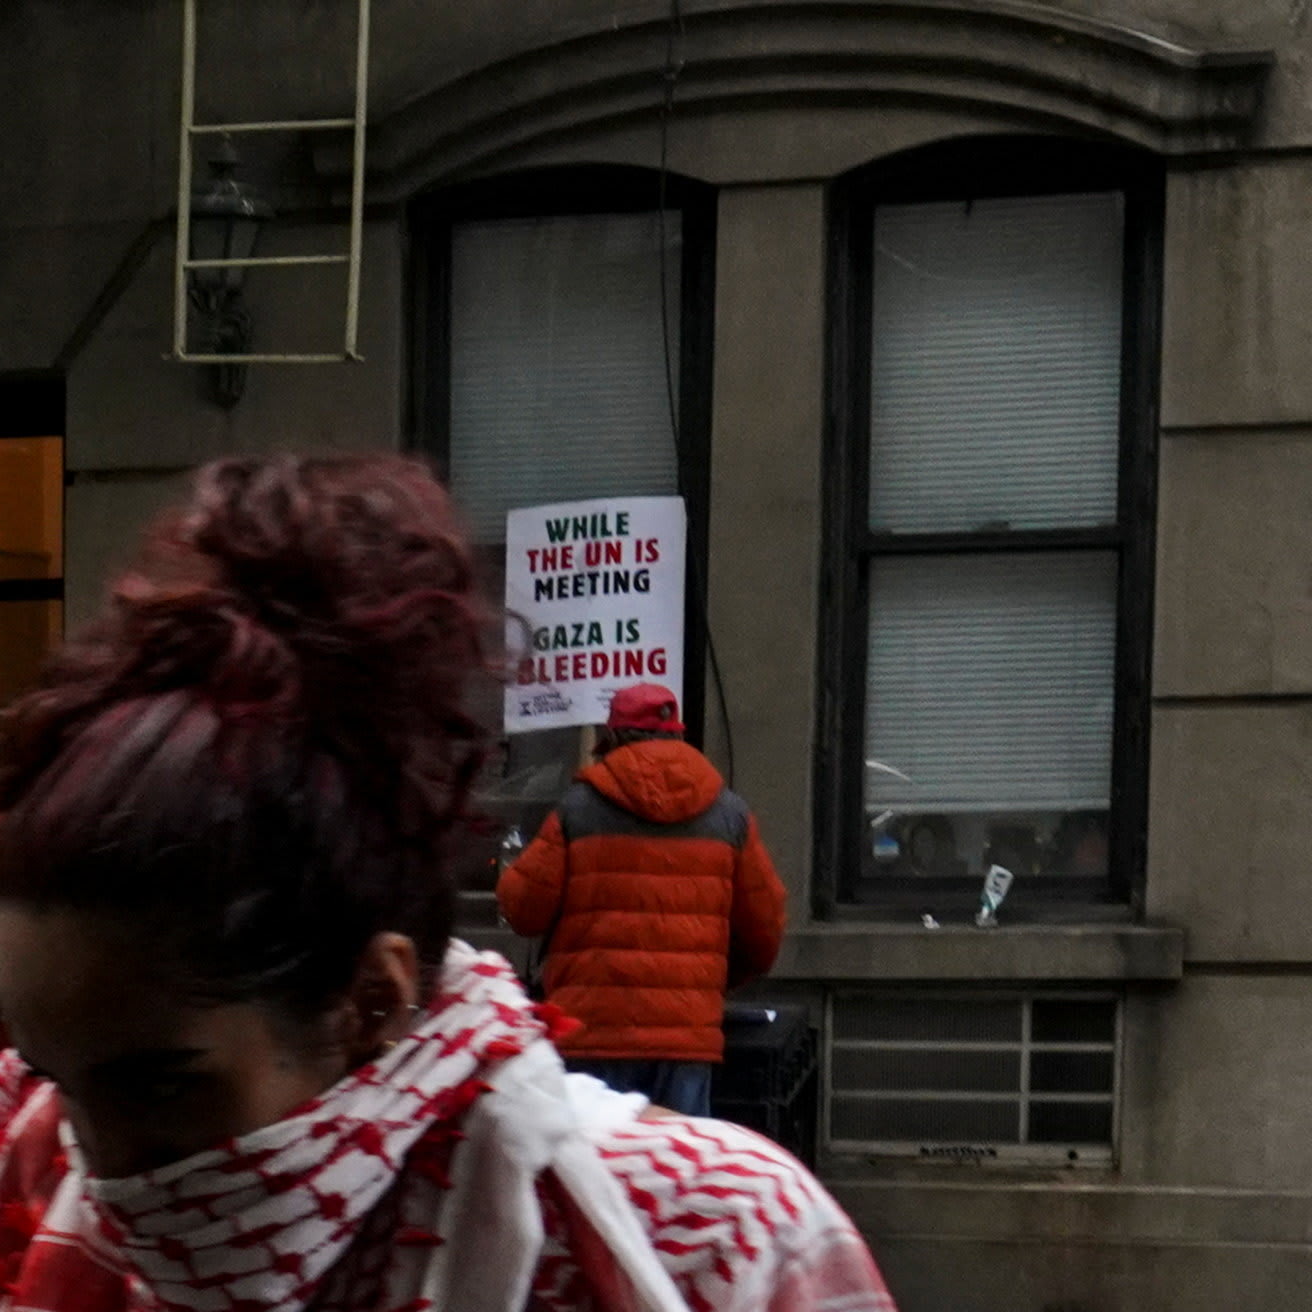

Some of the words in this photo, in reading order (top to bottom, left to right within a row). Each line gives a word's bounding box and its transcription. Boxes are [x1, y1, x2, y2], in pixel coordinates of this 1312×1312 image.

[545, 512, 630, 544] WHILE
[527, 545, 573, 573] THE
[585, 540, 622, 568] UN
[635, 538, 660, 564] IS
[534, 569, 651, 603] MEETING
[533, 621, 604, 651] GAZA
[616, 618, 640, 645] IS
[516, 647, 668, 685] BLEEDING
